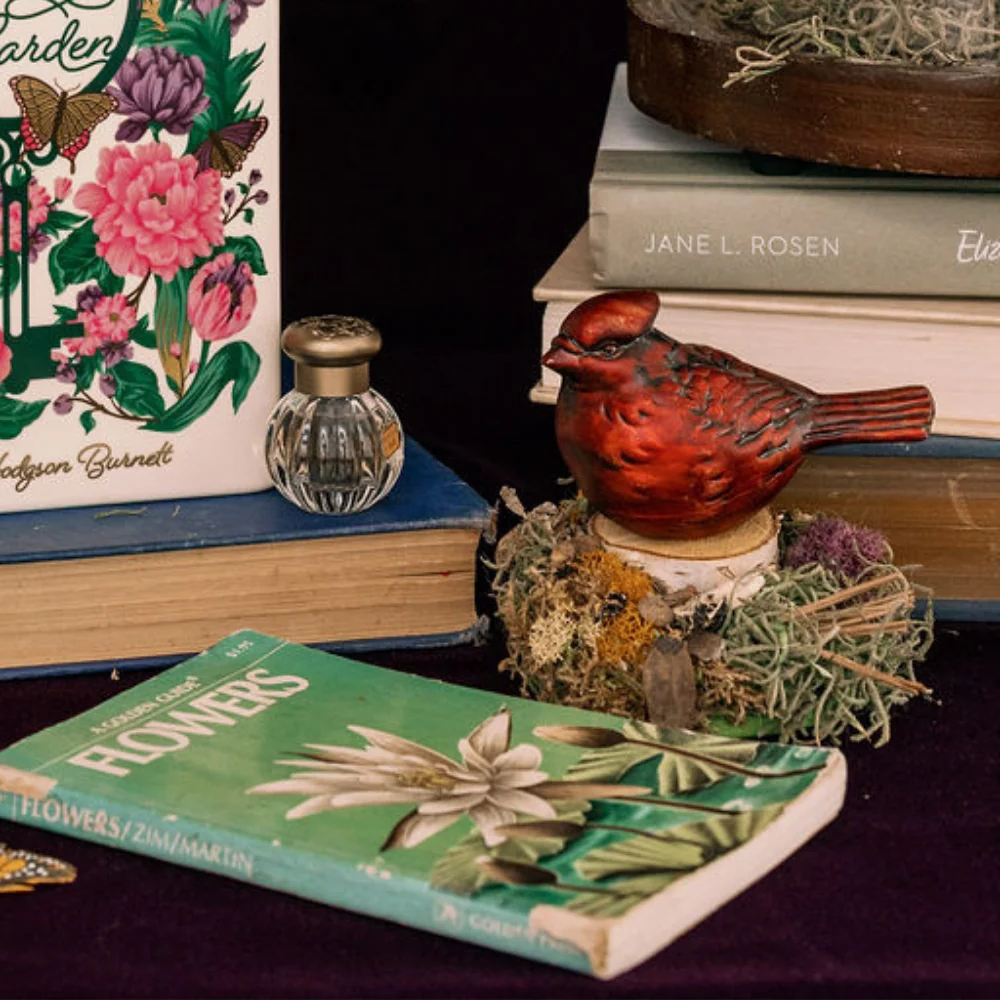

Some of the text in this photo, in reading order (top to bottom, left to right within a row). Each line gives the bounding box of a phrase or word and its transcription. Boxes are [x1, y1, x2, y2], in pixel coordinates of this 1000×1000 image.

[644, 233, 839, 257] JANE L. ROSEN
[77, 441, 174, 479] Burnett
[67, 669, 309, 778] FLOWERS
